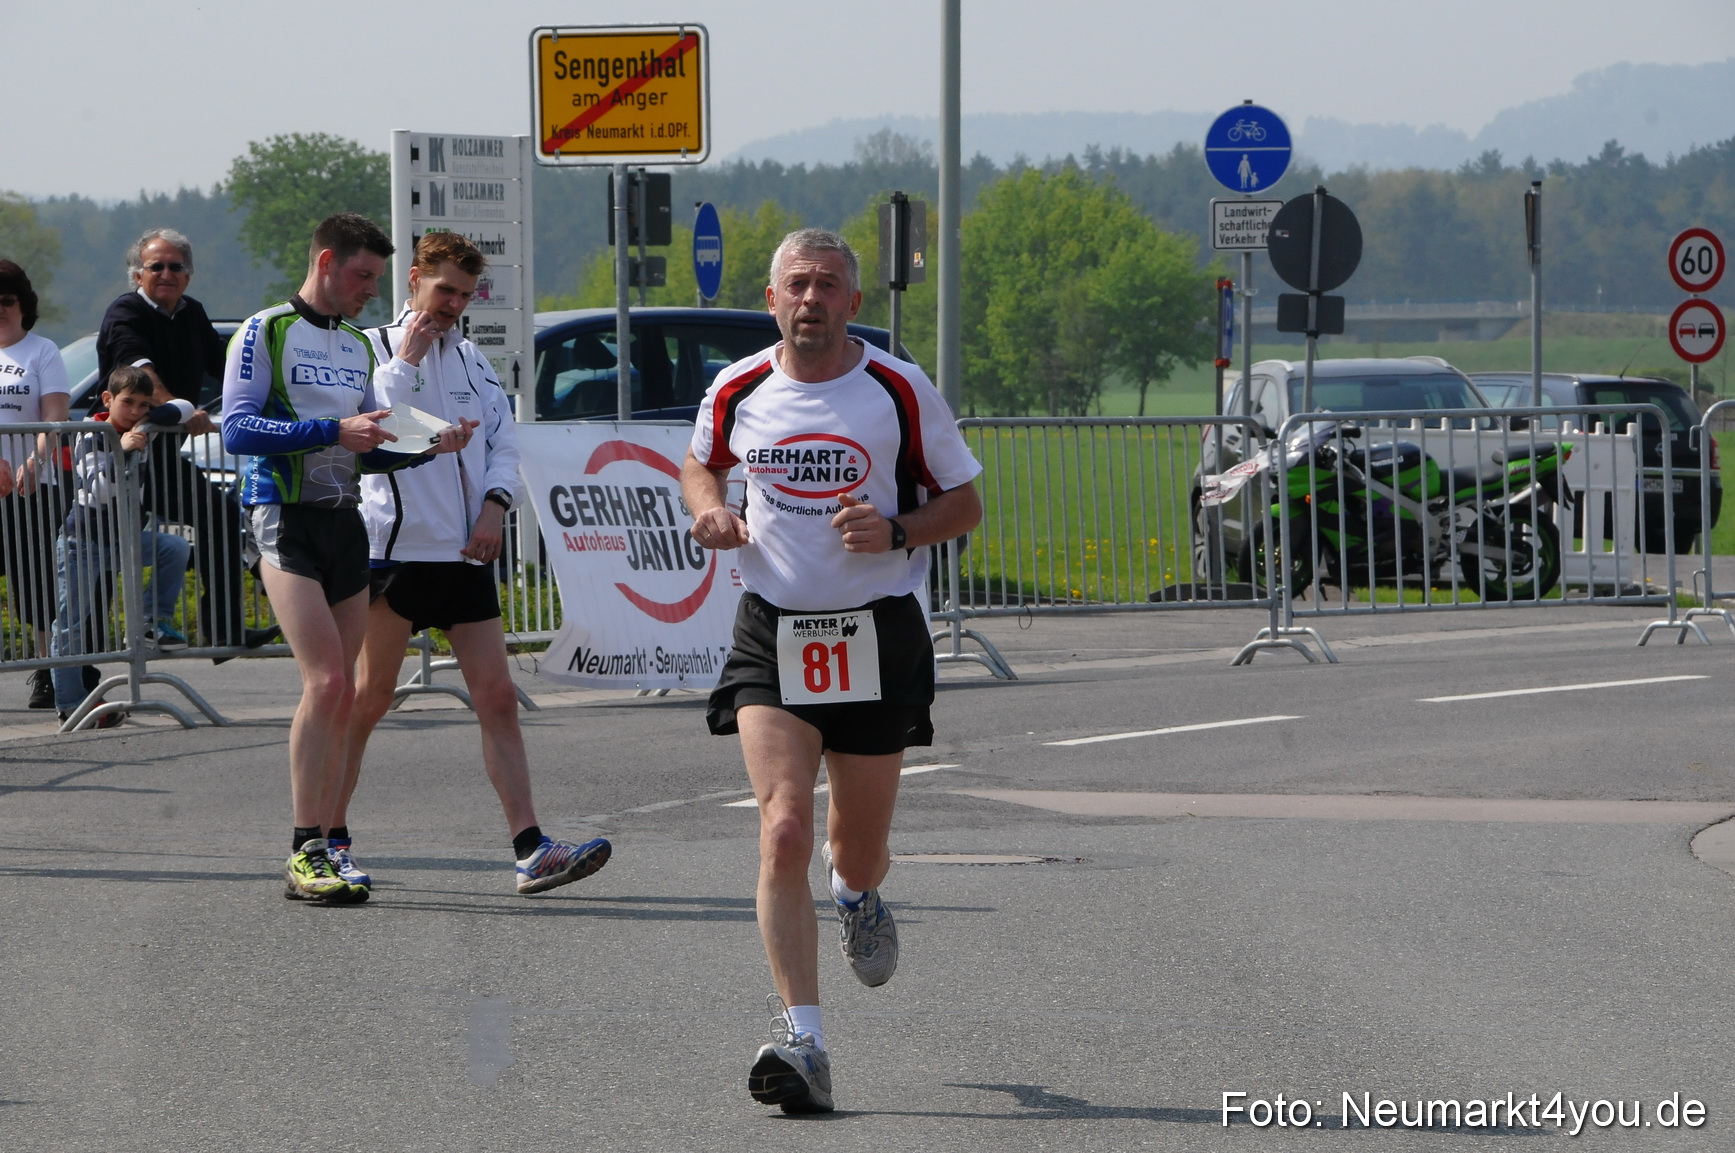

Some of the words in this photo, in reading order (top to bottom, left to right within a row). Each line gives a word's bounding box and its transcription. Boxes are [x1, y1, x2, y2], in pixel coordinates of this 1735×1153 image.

[554, 48, 685, 87] Sengenthal
[572, 93, 600, 107] am
[610, 88, 668, 111] Anger
[551, 124, 581, 140] Kreis
[586, 123, 645, 139] Neumarkt
[452, 138, 504, 158] HOLZAMMER
[453, 182, 505, 201] HOLZAMMER
[1224, 206, 1273, 217] Landwirt-
[1219, 233, 1257, 245] Verkehr
[1681, 246, 1713, 275] 60
[239, 317, 262, 380] BOCK
[294, 347, 329, 360] TEAM
[291, 363, 367, 392] BOCK
[238, 414, 292, 435] BOCK
[746, 448, 846, 465] GERHART
[848, 455, 857, 464] &
[749, 465, 789, 475] Autohaus
[787, 465, 859, 483] JÄNIG
[549, 484, 677, 528] GERHART
[761, 488, 775, 506] Das
[775, 500, 824, 517] sportliche
[562, 530, 627, 552] Autohaus
[626, 528, 707, 572] JÄNIG
[792, 617, 838, 630] MEYER
[793, 628, 839, 638] WERBUNG
[567, 646, 647, 676] Neumarkt
[655, 646, 713, 681] Sengenthal
[802, 641, 851, 694] 81
